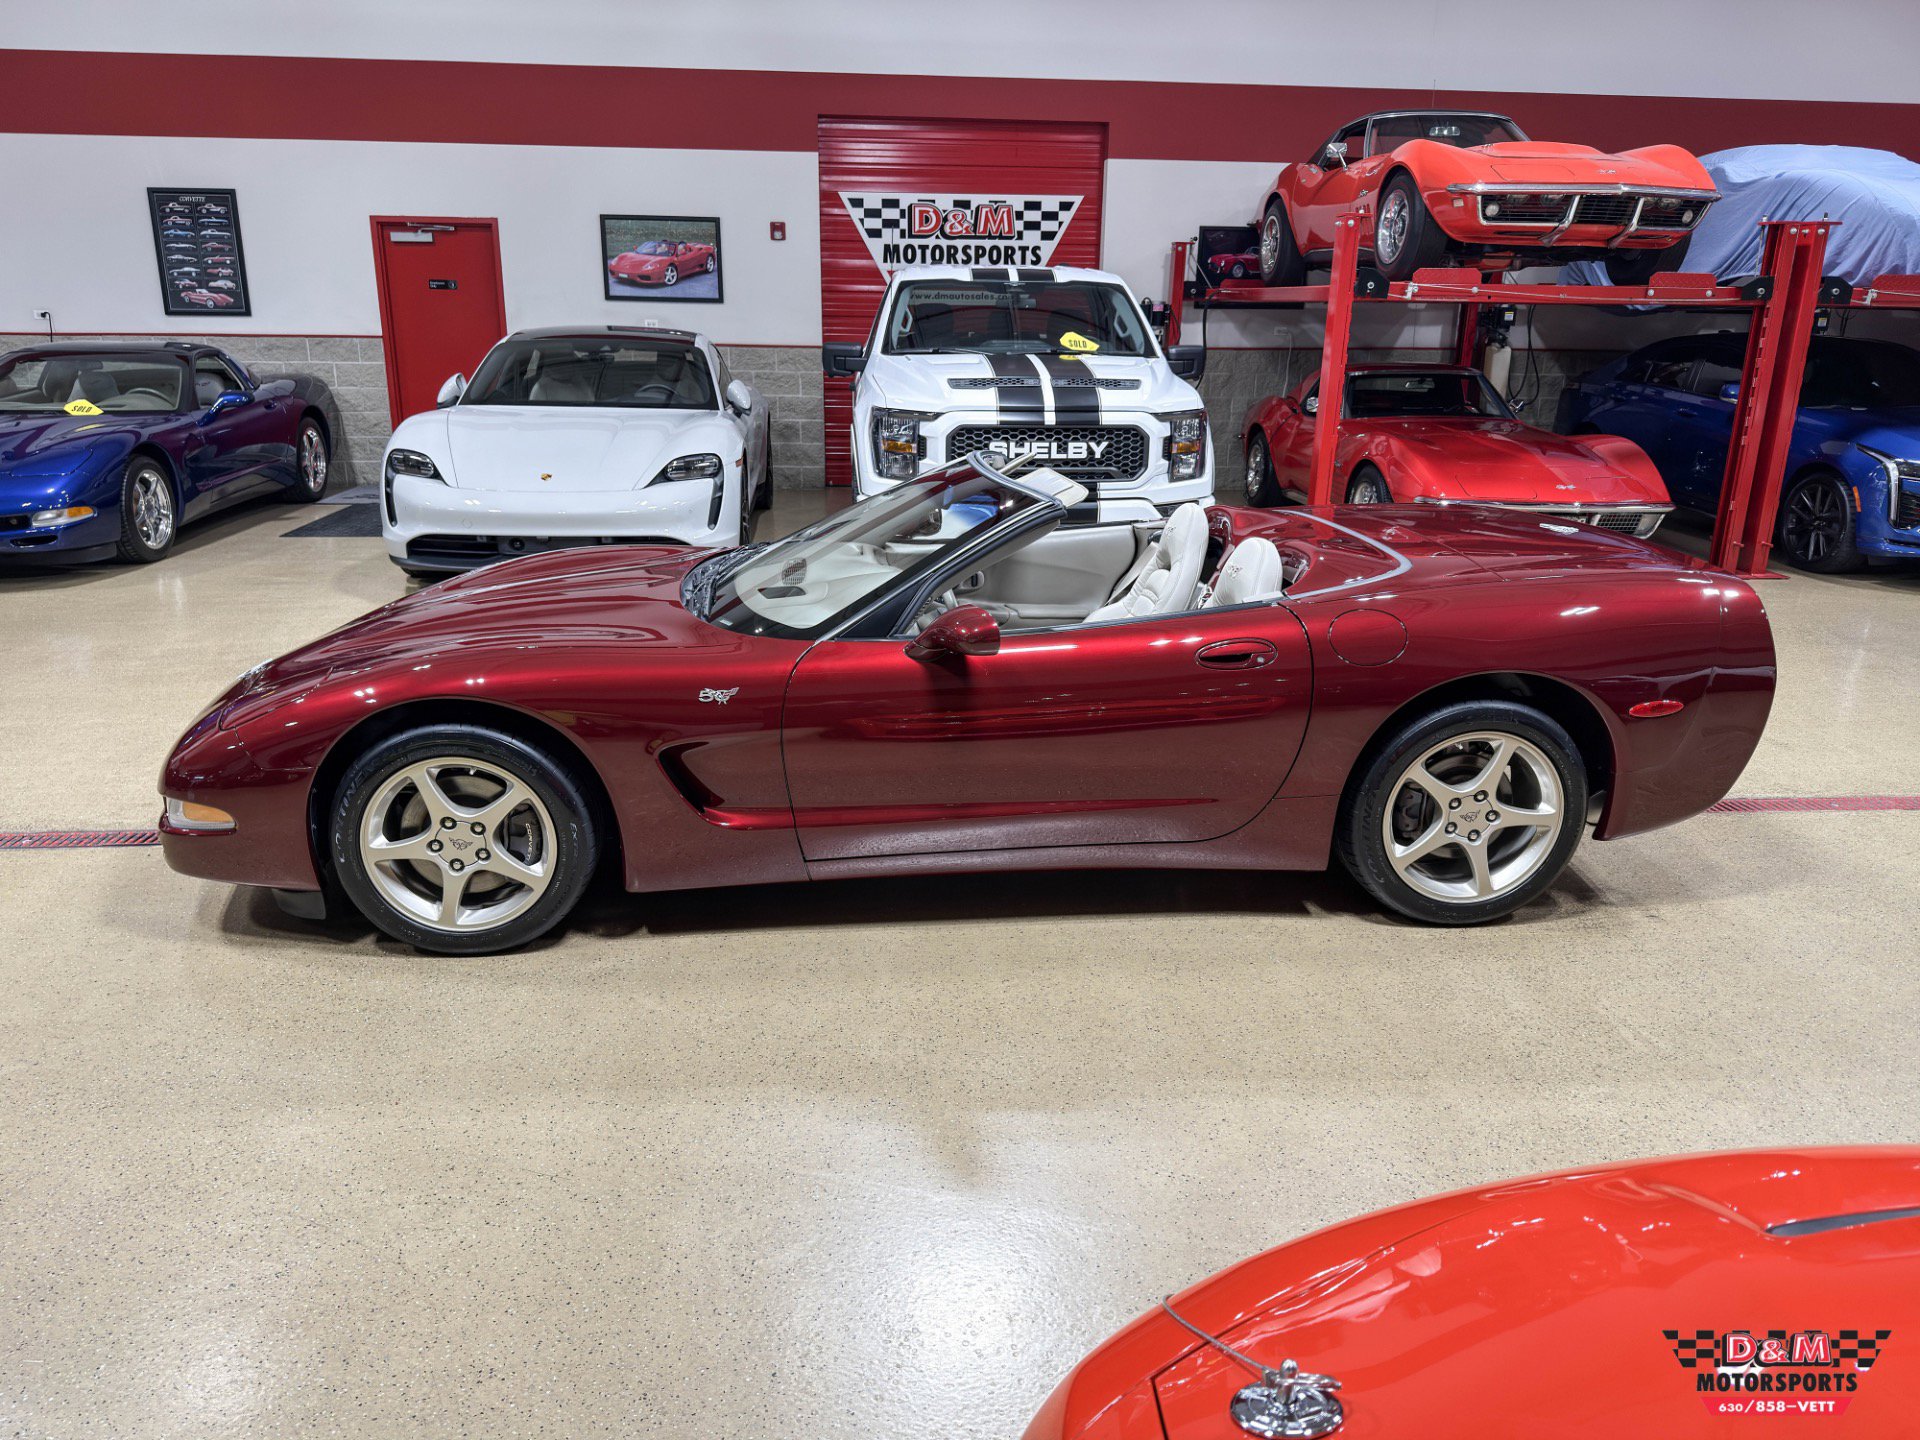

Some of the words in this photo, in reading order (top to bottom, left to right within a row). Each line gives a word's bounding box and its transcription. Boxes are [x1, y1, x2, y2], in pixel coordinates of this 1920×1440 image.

[908, 203, 1016, 240] D&M
[882, 244, 1042, 265] MOTORSPORTS
[1068, 339, 1088, 348] SOLD
[71, 405, 93, 413] SOLD
[989, 441, 1109, 459] SHELBY
